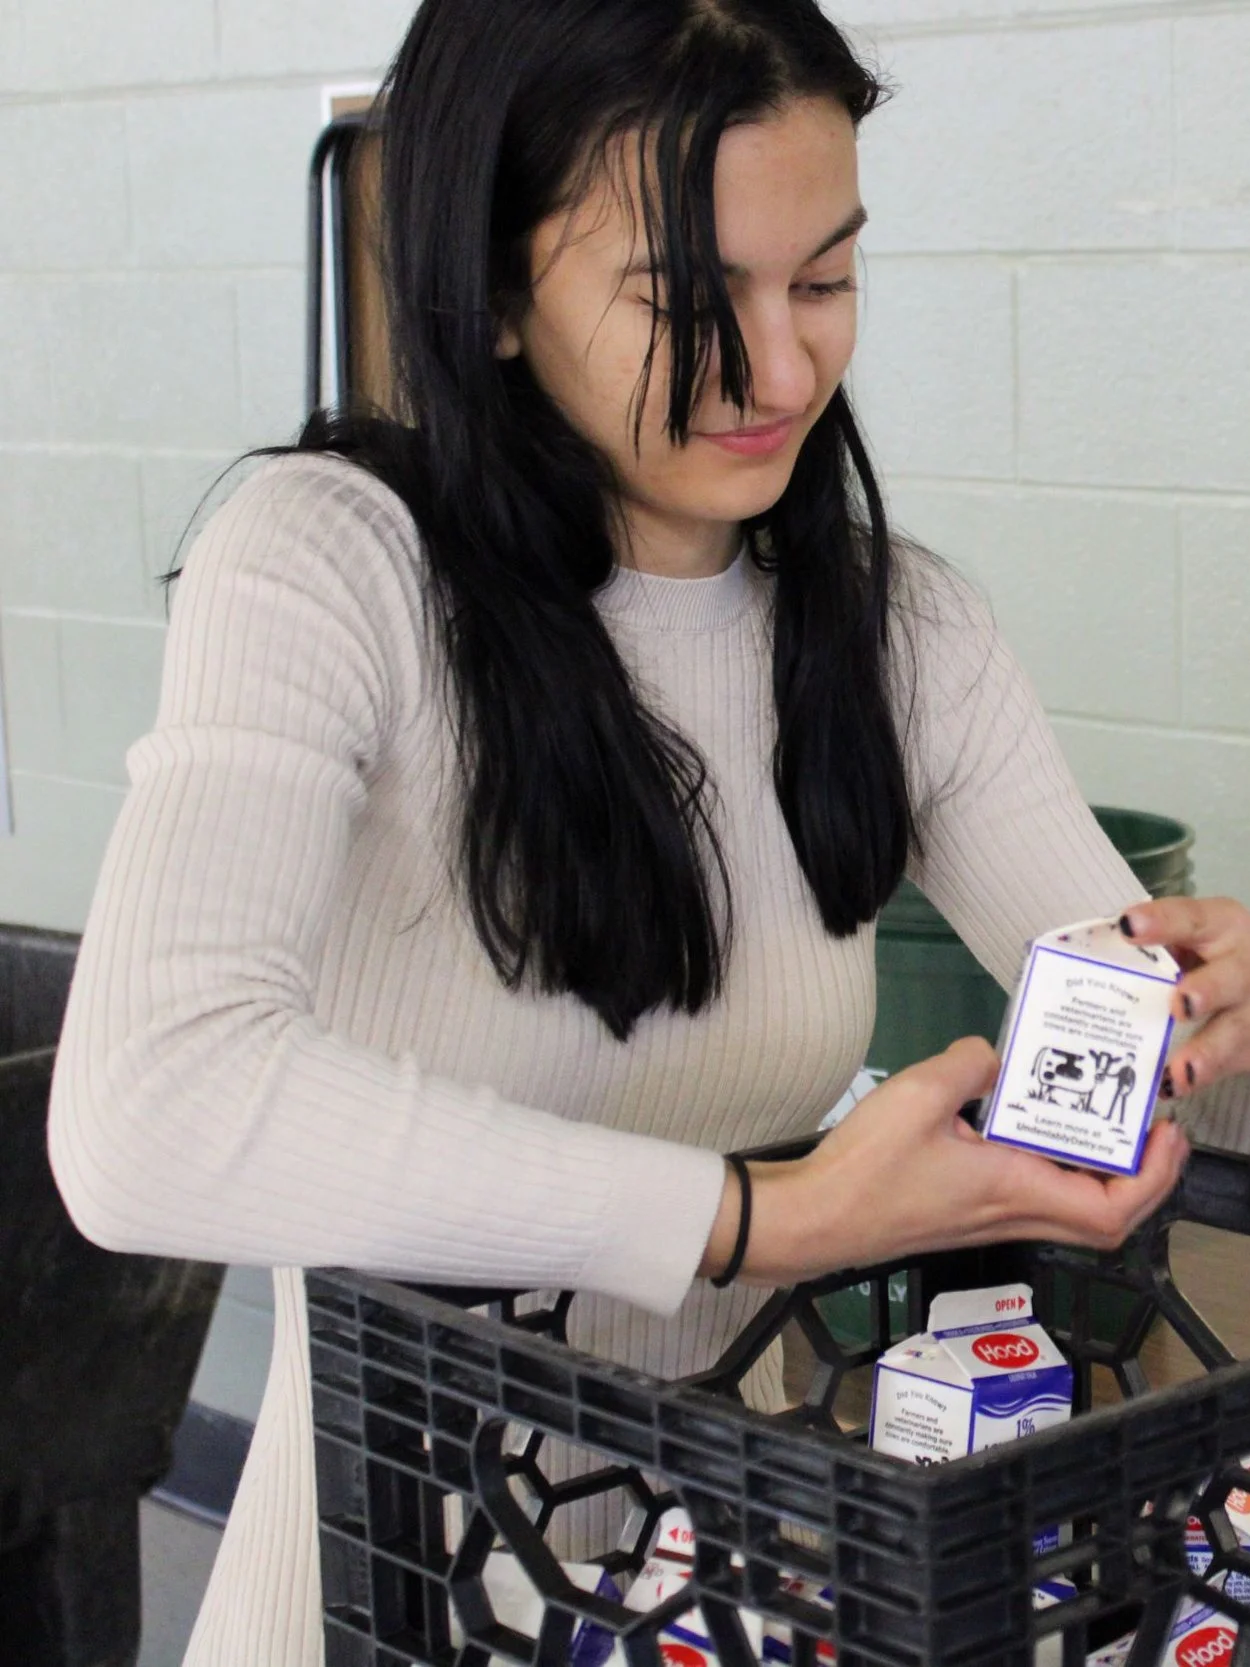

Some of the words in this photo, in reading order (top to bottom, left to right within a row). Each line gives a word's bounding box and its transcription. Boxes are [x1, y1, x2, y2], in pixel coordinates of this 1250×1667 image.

[995, 1298, 1016, 1312] OPEN
[978, 1339, 1034, 1361] Hood
[1017, 1418, 1035, 1439] 1%
[1181, 1630, 1235, 1667] Hood
